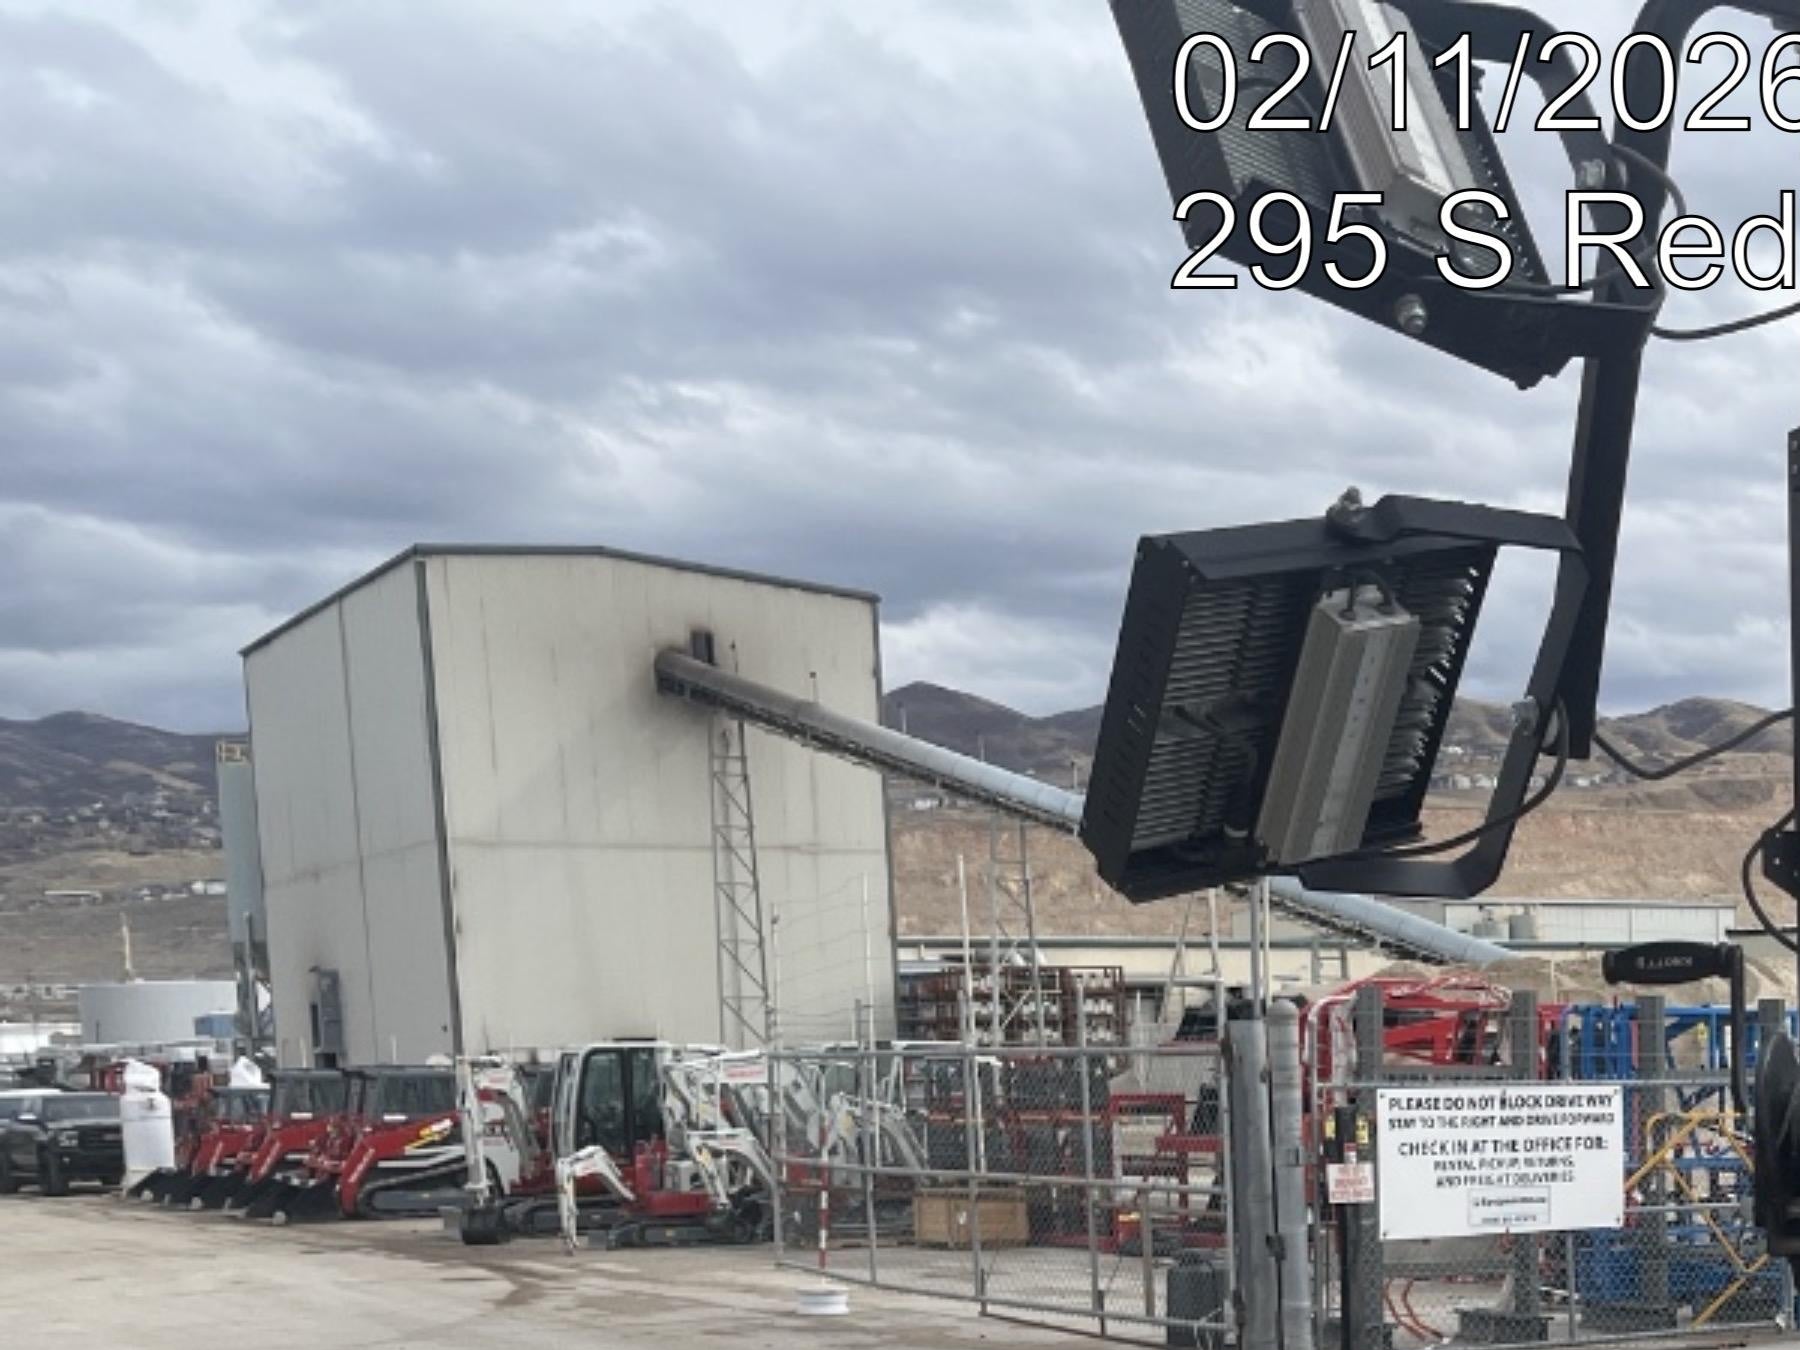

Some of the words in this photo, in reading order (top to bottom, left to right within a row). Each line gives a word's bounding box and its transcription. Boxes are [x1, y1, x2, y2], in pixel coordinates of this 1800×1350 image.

[1389, 1096, 1440, 1111] PLEASE
[1443, 1096, 1464, 1110] DO
[1467, 1095, 1495, 1110] NOT
[1499, 1094, 1542, 1110] BLOCK
[1544, 1094, 1584, 1108] DRIVE
[1437, 1116, 1458, 1128] THE
[1461, 1115, 1496, 1128] RIGHT
[1499, 1114, 1524, 1126] AND
[1398, 1140, 1449, 1156] CHECK
[1451, 1139, 1468, 1155] IN
[1472, 1139, 1488, 1153] AT
[1491, 1139, 1519, 1153] THE
[1523, 1136, 1572, 1152] OFFICE
